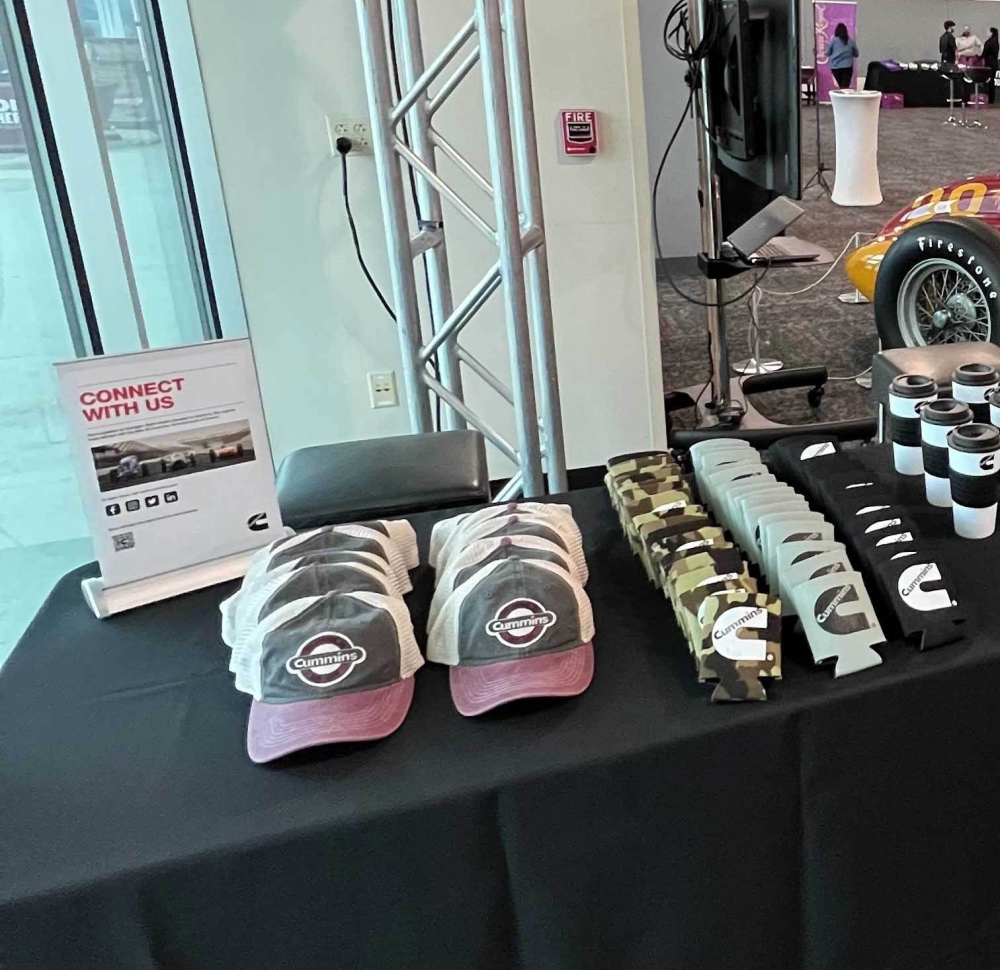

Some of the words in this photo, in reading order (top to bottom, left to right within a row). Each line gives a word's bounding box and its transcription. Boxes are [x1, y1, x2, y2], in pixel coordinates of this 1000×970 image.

[565, 112, 592, 122] FIRE
[917, 236, 998, 299] Firestone
[79, 378, 185, 406] CONNECT
[82, 402, 139, 422] WITH
[145, 396, 175, 412] US
[902, 563, 933, 597] Cummins
[816, 584, 852, 623] Cummins
[491, 614, 549, 632] Cummins
[713, 607, 763, 640] Cummins
[294, 650, 358, 670] Cummins
